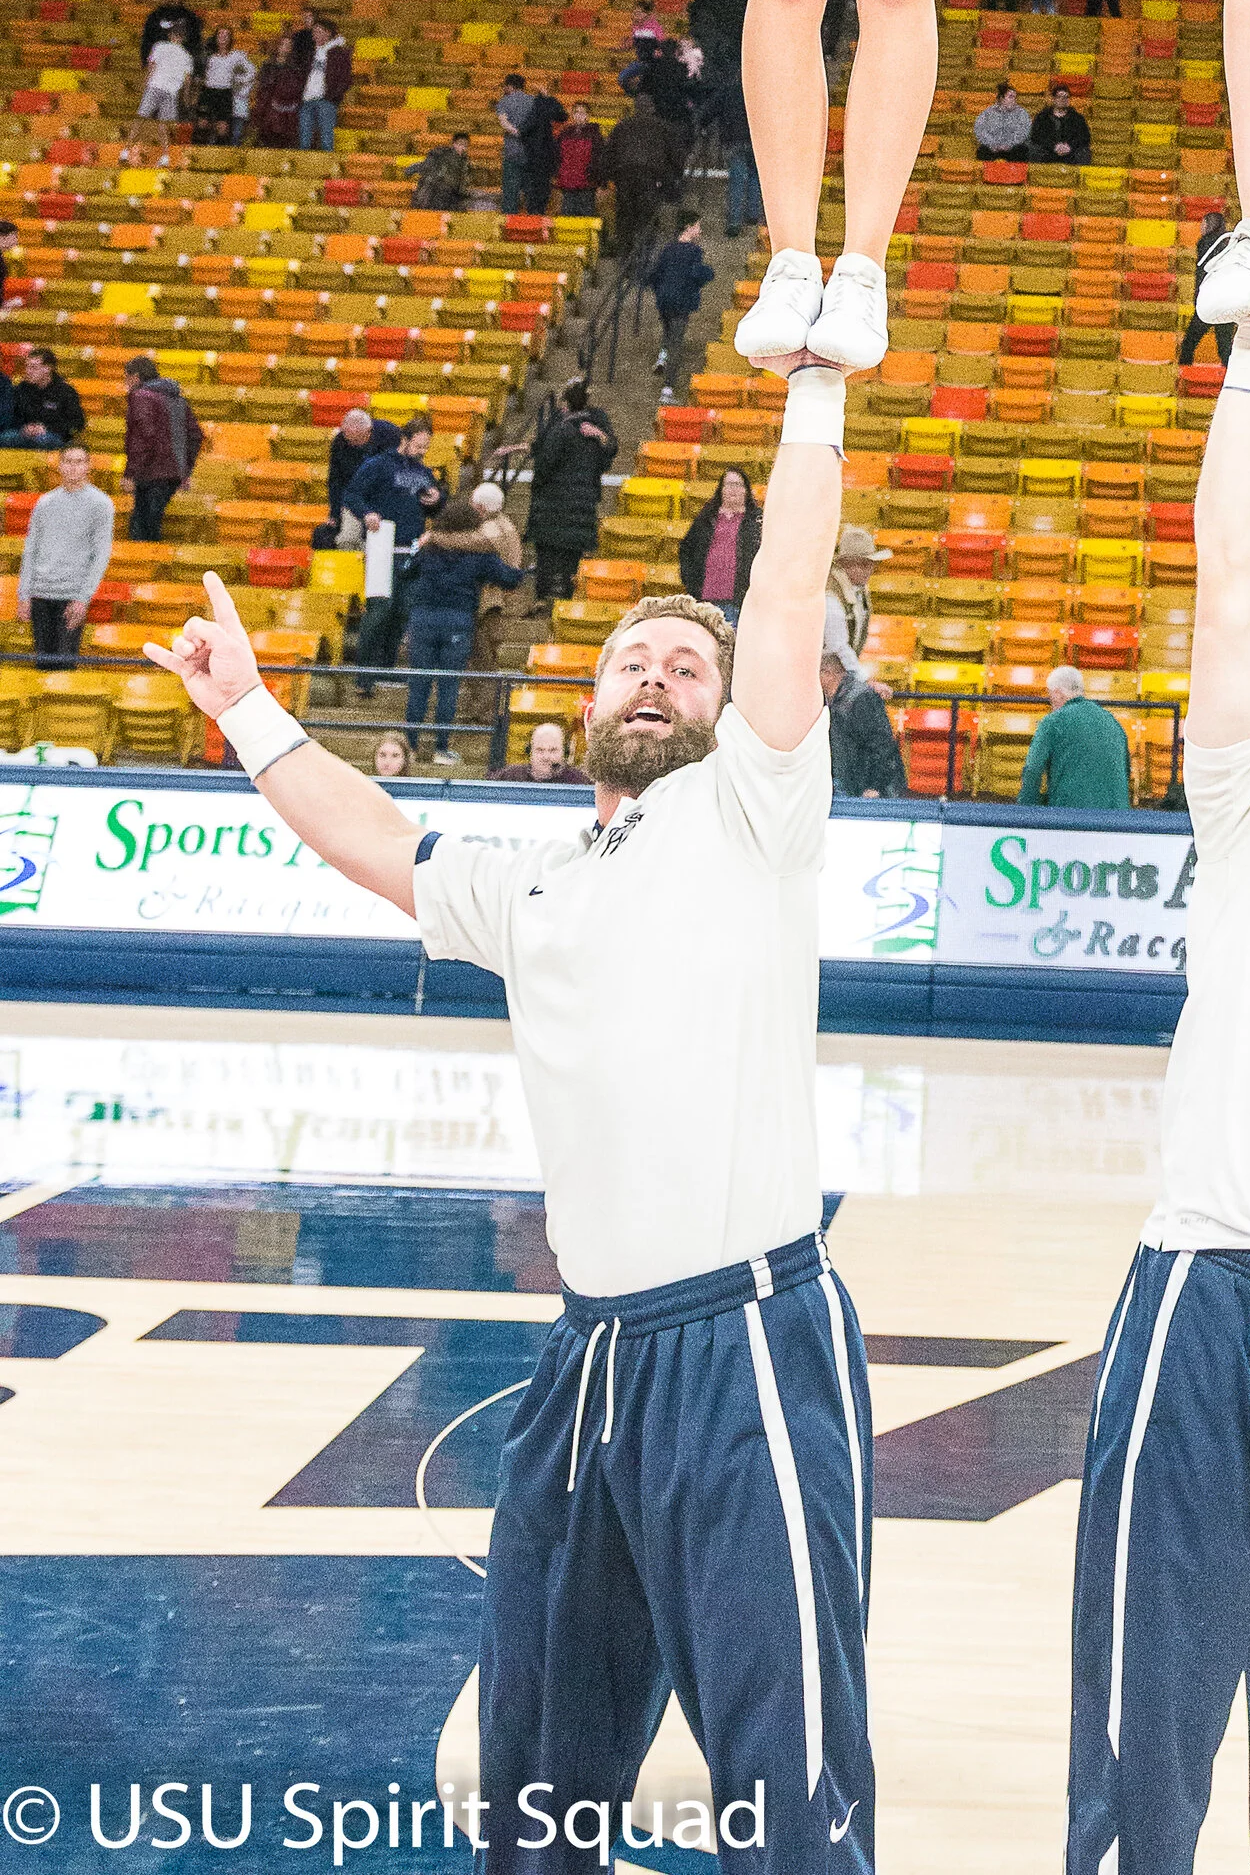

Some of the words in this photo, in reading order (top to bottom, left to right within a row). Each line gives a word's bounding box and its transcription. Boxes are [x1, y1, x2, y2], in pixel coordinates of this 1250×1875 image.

[95, 798, 276, 873] Sports
[985, 834, 1160, 911] Sports
[1031, 910, 1082, 959] &
